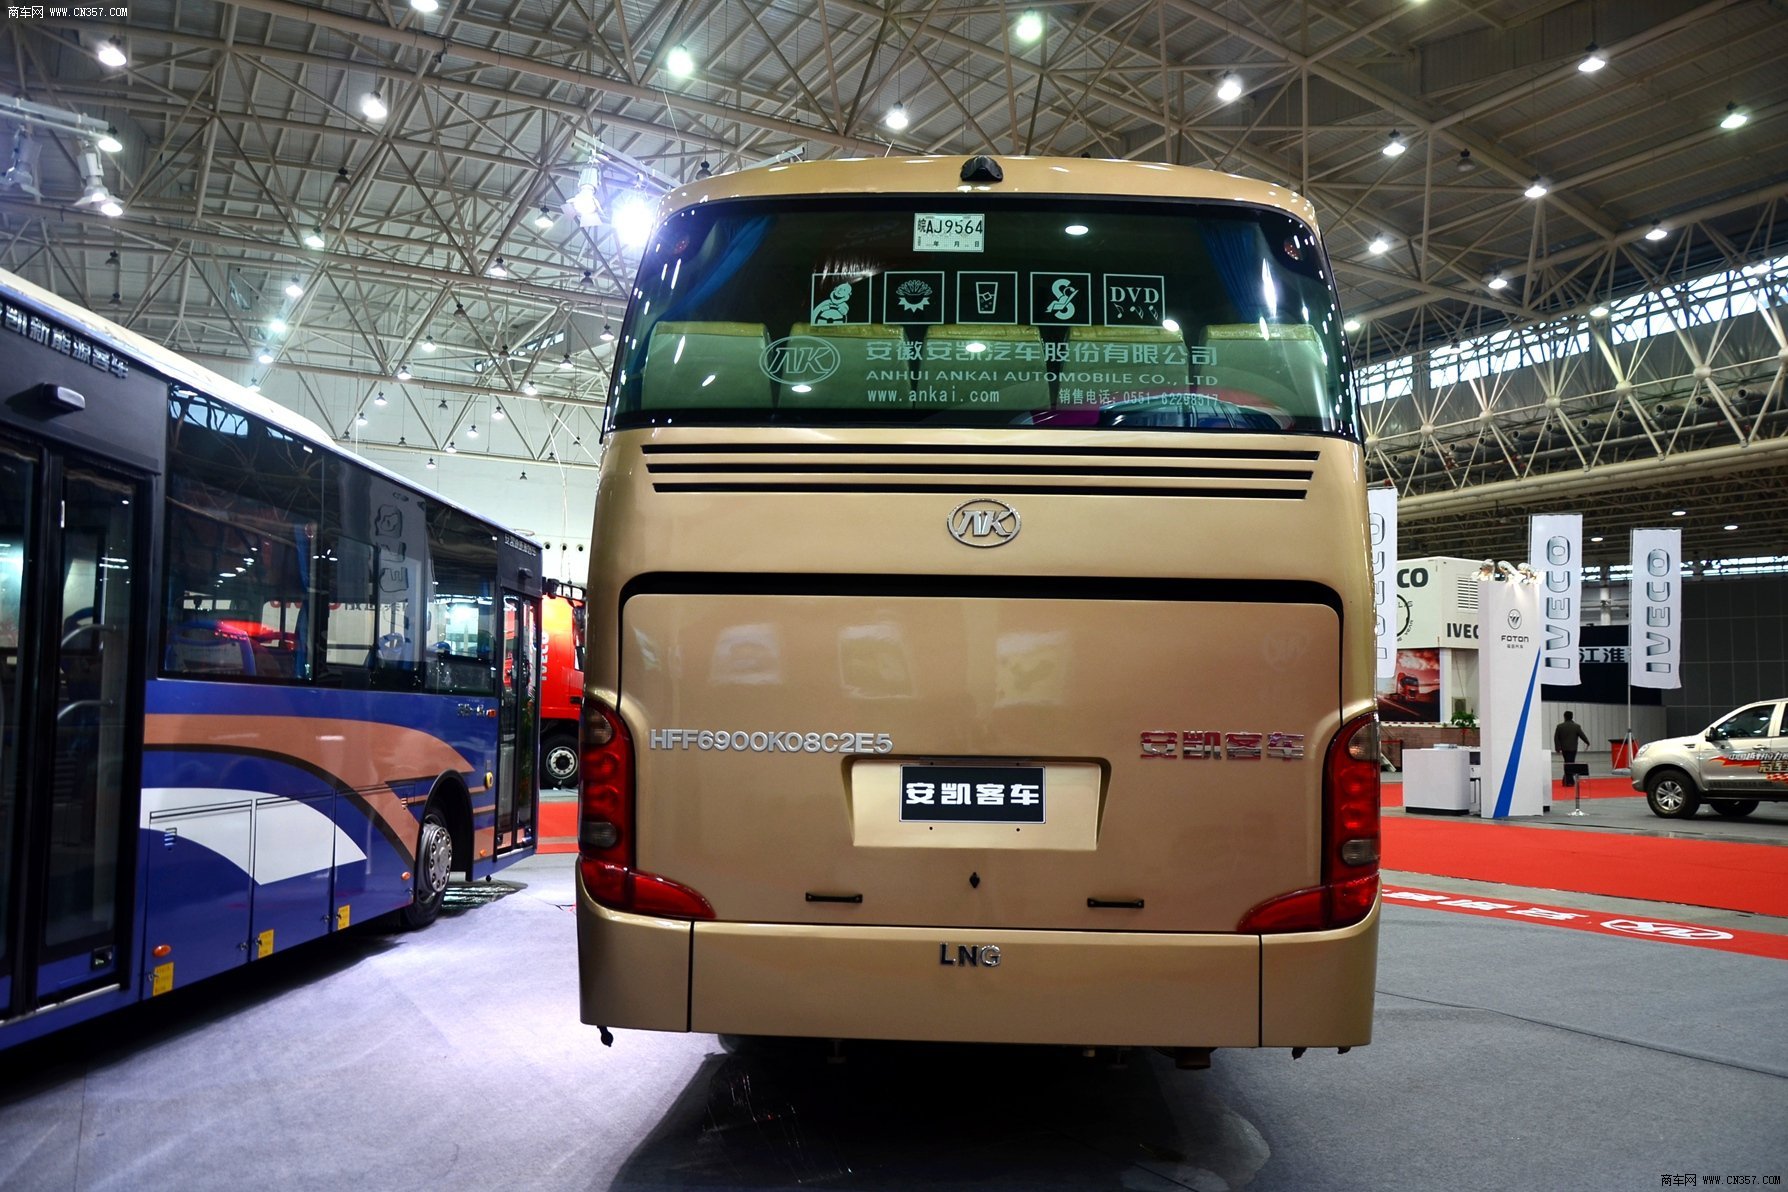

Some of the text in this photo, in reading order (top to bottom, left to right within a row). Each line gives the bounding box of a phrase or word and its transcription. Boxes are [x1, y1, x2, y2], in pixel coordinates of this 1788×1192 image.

[918, 218, 983, 234] 皖AJ9564
[1110, 286, 1160, 304] DVD
[0, 302, 129, 379] 凯新能源客车
[866, 341, 1218, 366] 安徽安凯汽车股份有限公司
[866, 370, 1218, 386] ANHUI ANKAI AUTOMOBILE CO., LTD
[867, 386, 1000, 402] www.ankai.com
[1545, 535, 1571, 669] IVECO
[1646, 548, 1671, 673] IVECO
[1579, 647, 1625, 663] 江淮
[1140, 730, 1305, 760] 安凯客车
[906, 782, 1039, 806] 安凯客车
[939, 942, 1001, 968] LNG
